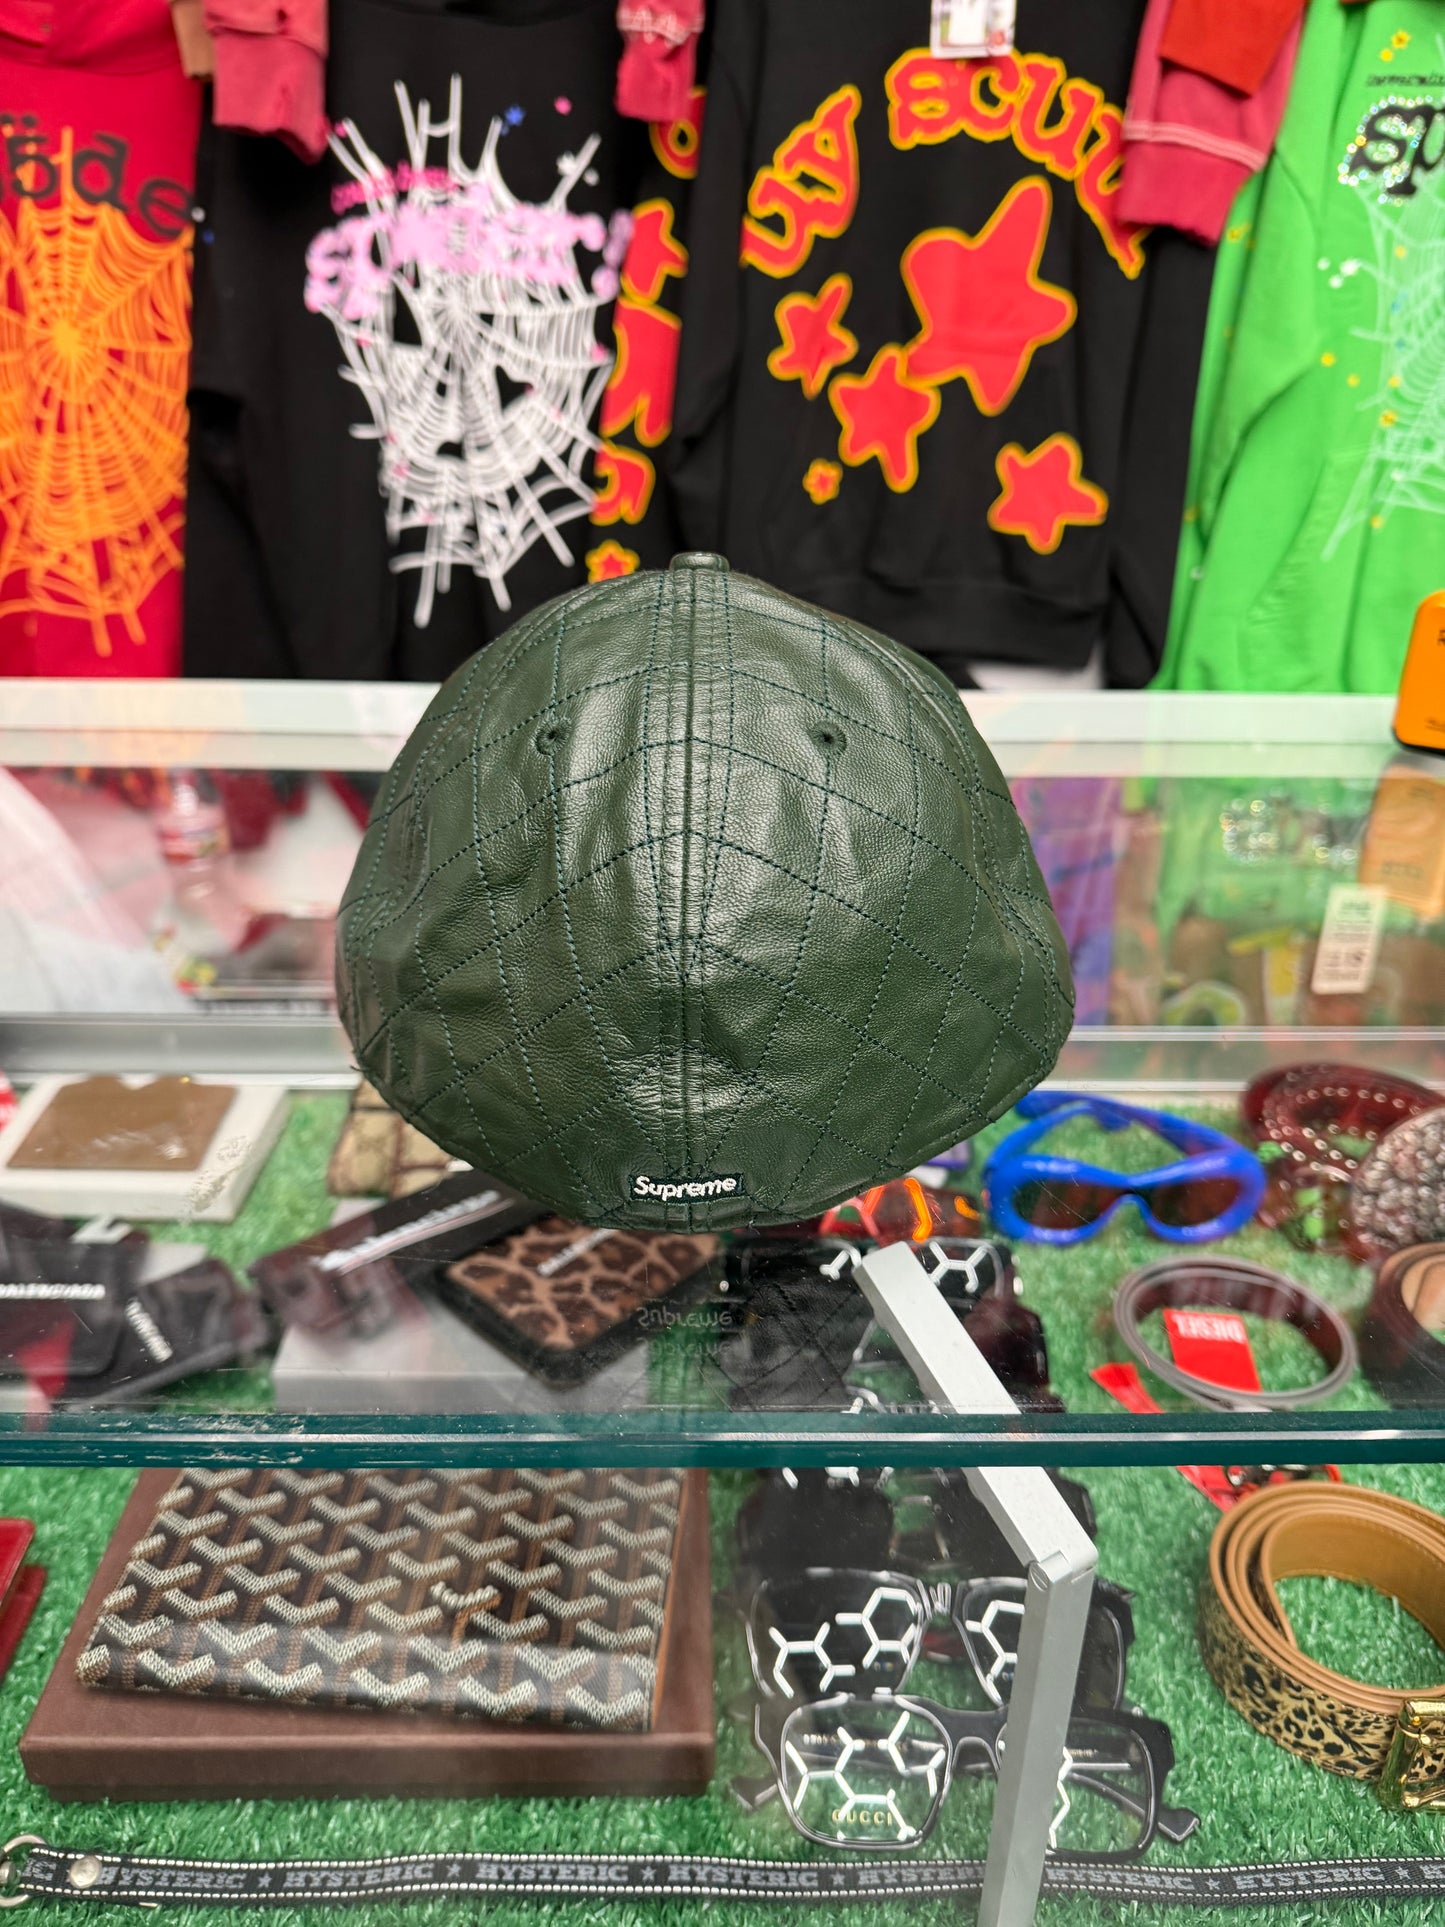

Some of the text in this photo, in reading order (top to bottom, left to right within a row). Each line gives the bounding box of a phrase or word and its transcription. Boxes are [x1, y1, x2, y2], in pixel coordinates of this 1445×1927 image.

[633, 1175, 737, 1201] Supreme
[283, 1862, 435, 1888] HYSTERIC
[475, 1861, 629, 1882] HYSTERIC
[667, 1863, 818, 1888] HYSTERIC
[1045, 1867, 1196, 1890] HYSTERIC
[1233, 1865, 1386, 1889] HYSTERIC
